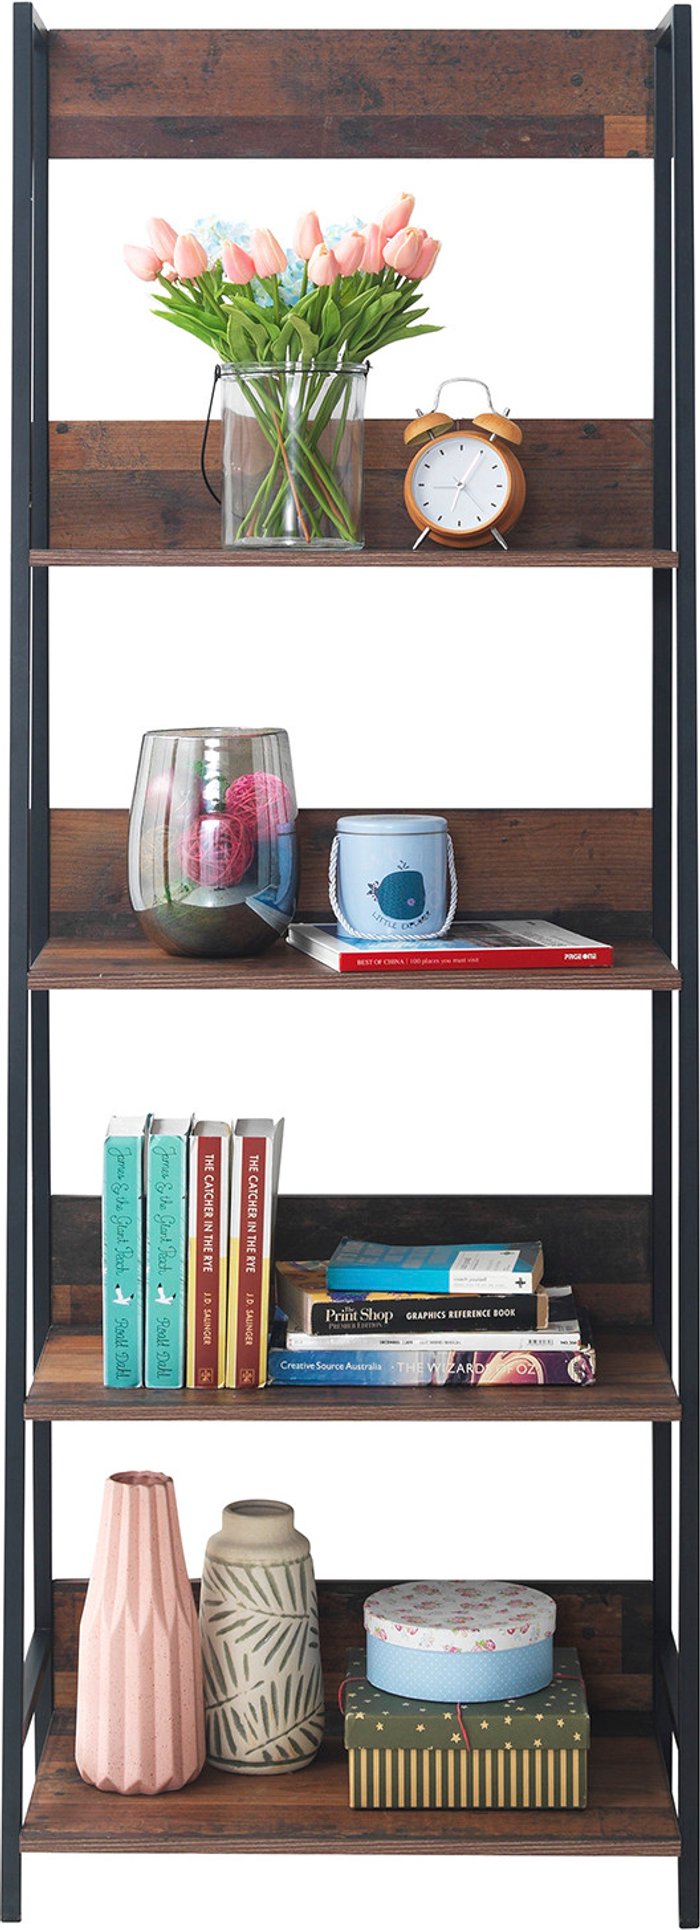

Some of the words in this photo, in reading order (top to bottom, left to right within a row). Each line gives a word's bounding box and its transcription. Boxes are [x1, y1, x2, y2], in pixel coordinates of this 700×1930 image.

[371, 911, 397, 929] LITTLE
[421, 957, 440, 965] places
[108, 1147, 132, 1180] James
[152, 1146, 177, 1179] James
[204, 1154, 215, 1171] THE
[249, 1155, 259, 1172] THE
[116, 1197, 129, 1212] the
[159, 1196, 173, 1211] the
[204, 1175, 215, 1218] CATCHER
[247, 1175, 258, 1218] CATCHER
[204, 1221, 214, 1232] IN
[247, 1221, 257, 1233] IN
[203, 1234, 213, 1252] THE
[246, 1235, 257, 1253] THE
[203, 1255, 213, 1272] RYE
[245, 1256, 256, 1273] RYE
[326, 1309, 357, 1322] Print
[360, 1307, 393, 1324] Shop
[405, 1311, 446, 1320] GRAPHICS
[448, 1309, 490, 1319] REFERENCE
[493, 1308, 515, 1317] BOOK
[114, 1318, 129, 1348] Roald
[156, 1317, 170, 1347] Roald
[203, 1309, 212, 1345] SALINGER
[245, 1310, 254, 1345] SALINGER
[115, 1352, 131, 1380] Dahl
[157, 1351, 172, 1379] Dahl
[280, 1361, 315, 1370] Creative
[316, 1361, 344, 1370] Source
[345, 1361, 382, 1370] Australia
[396, 1362, 424, 1373] THE
[516, 1364, 536, 1375] OZ
